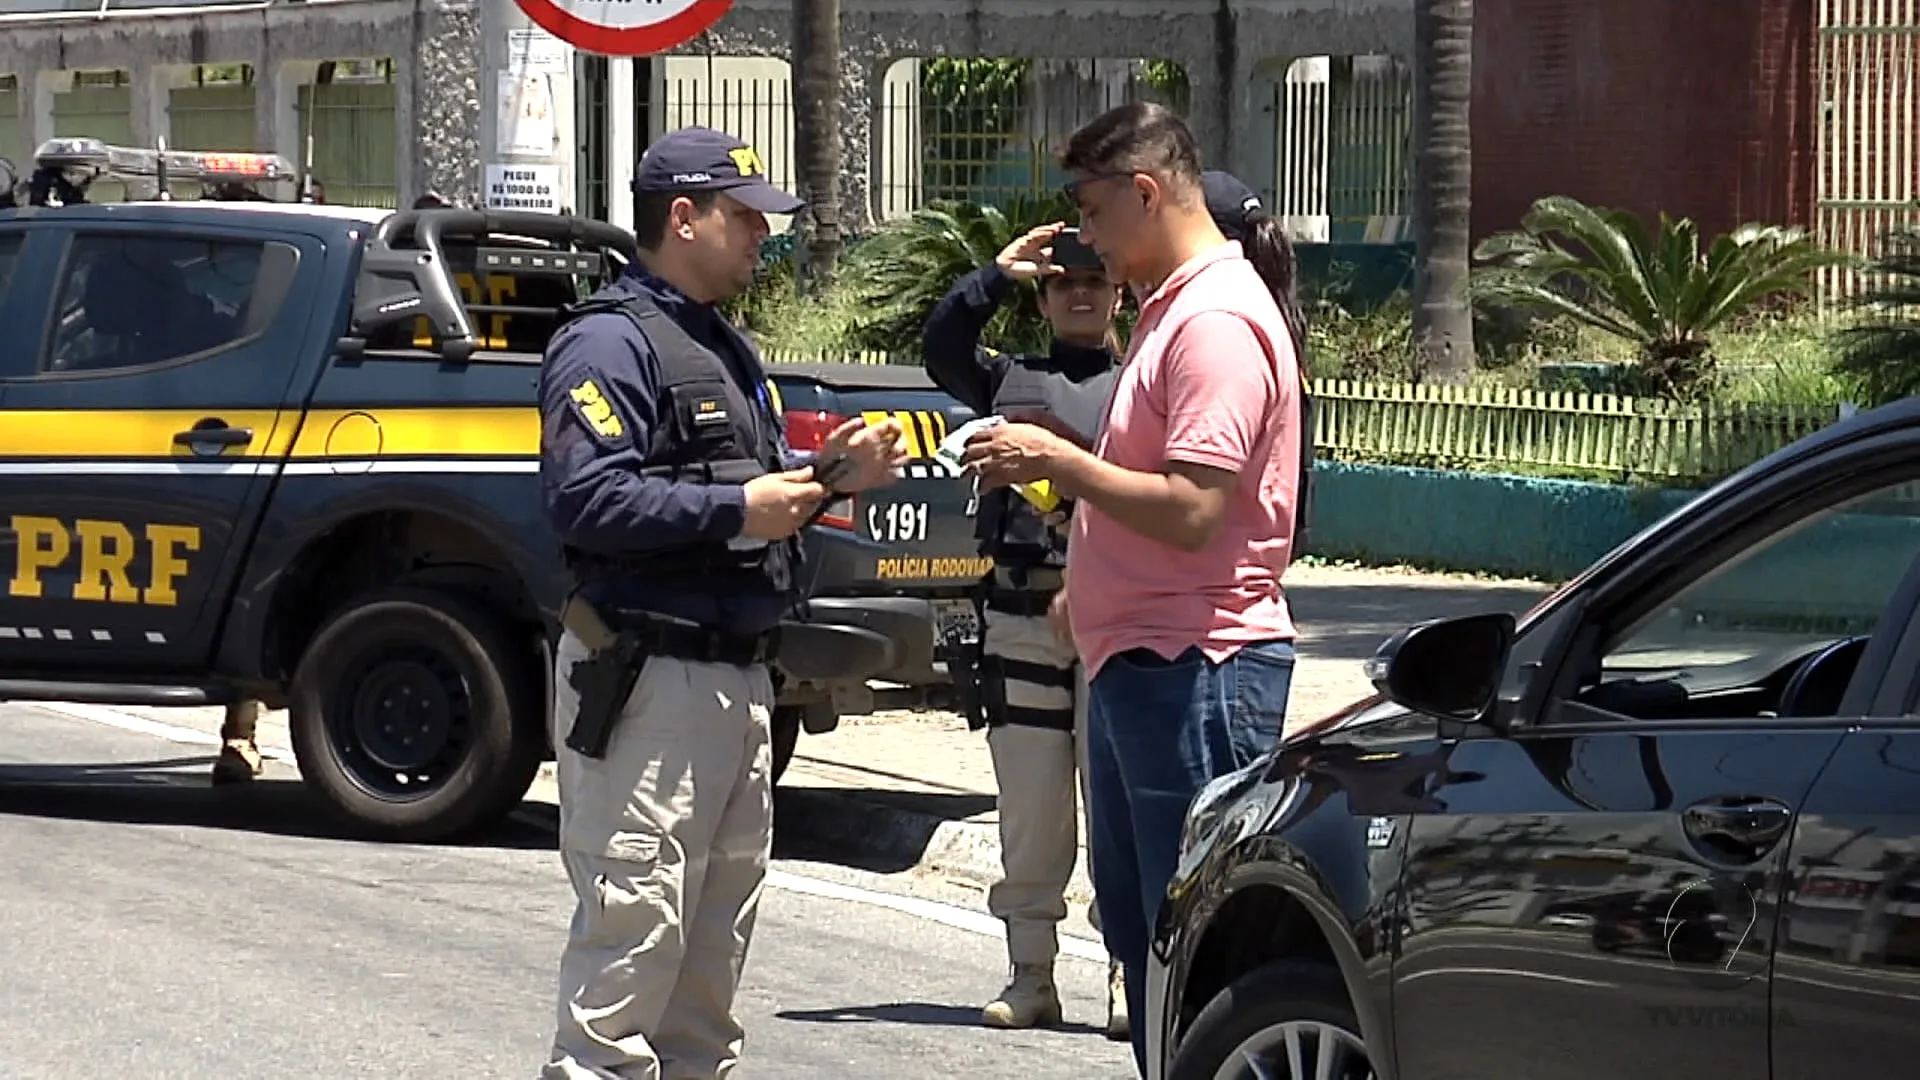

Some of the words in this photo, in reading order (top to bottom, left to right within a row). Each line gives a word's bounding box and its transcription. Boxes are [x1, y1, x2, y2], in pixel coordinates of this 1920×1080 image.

[569, 379, 623, 437] PRF
[886, 502, 928, 541] 191
[8, 515, 201, 606] PRF
[876, 553, 928, 579] POLÍCIA
